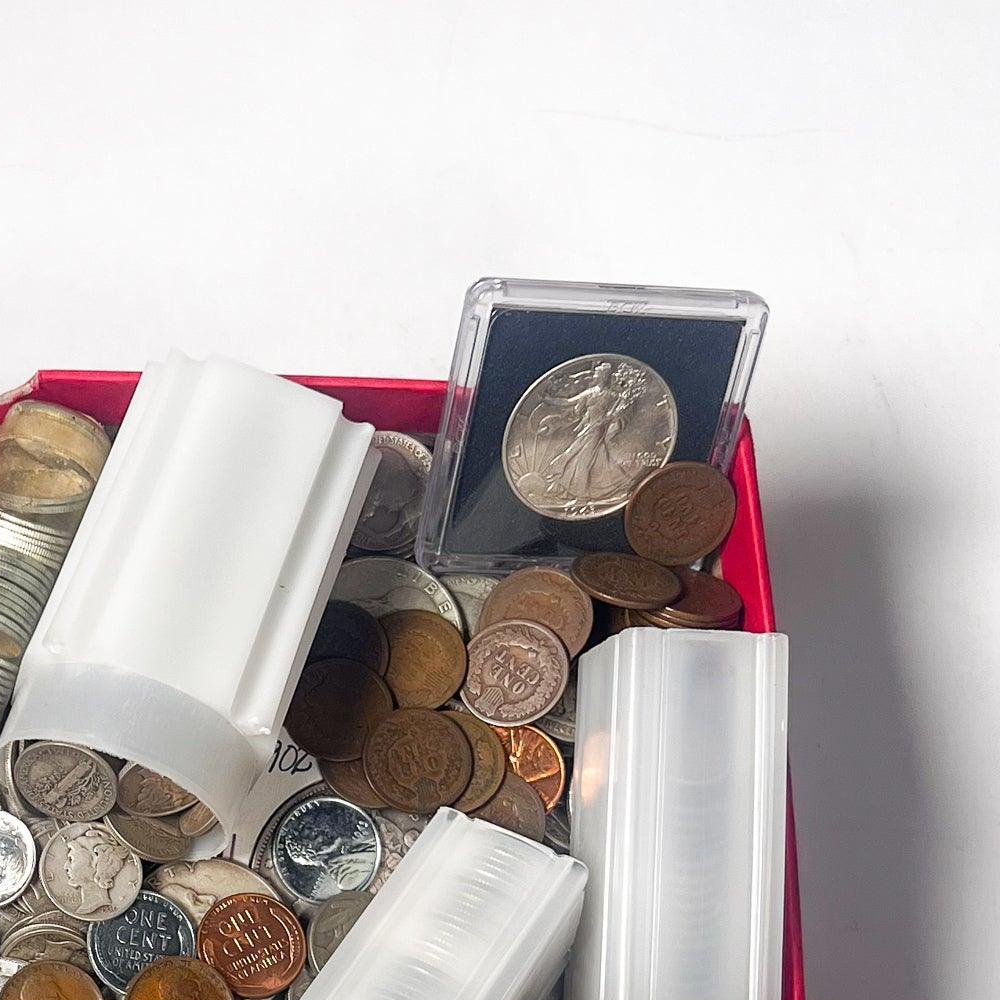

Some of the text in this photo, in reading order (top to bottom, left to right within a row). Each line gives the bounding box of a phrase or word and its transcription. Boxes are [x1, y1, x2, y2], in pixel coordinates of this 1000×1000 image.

[488, 665, 527, 695] ONE
[494, 650, 540, 686] CENT
[124, 909, 168, 931] ONE
[117, 925, 172, 952] CENT
